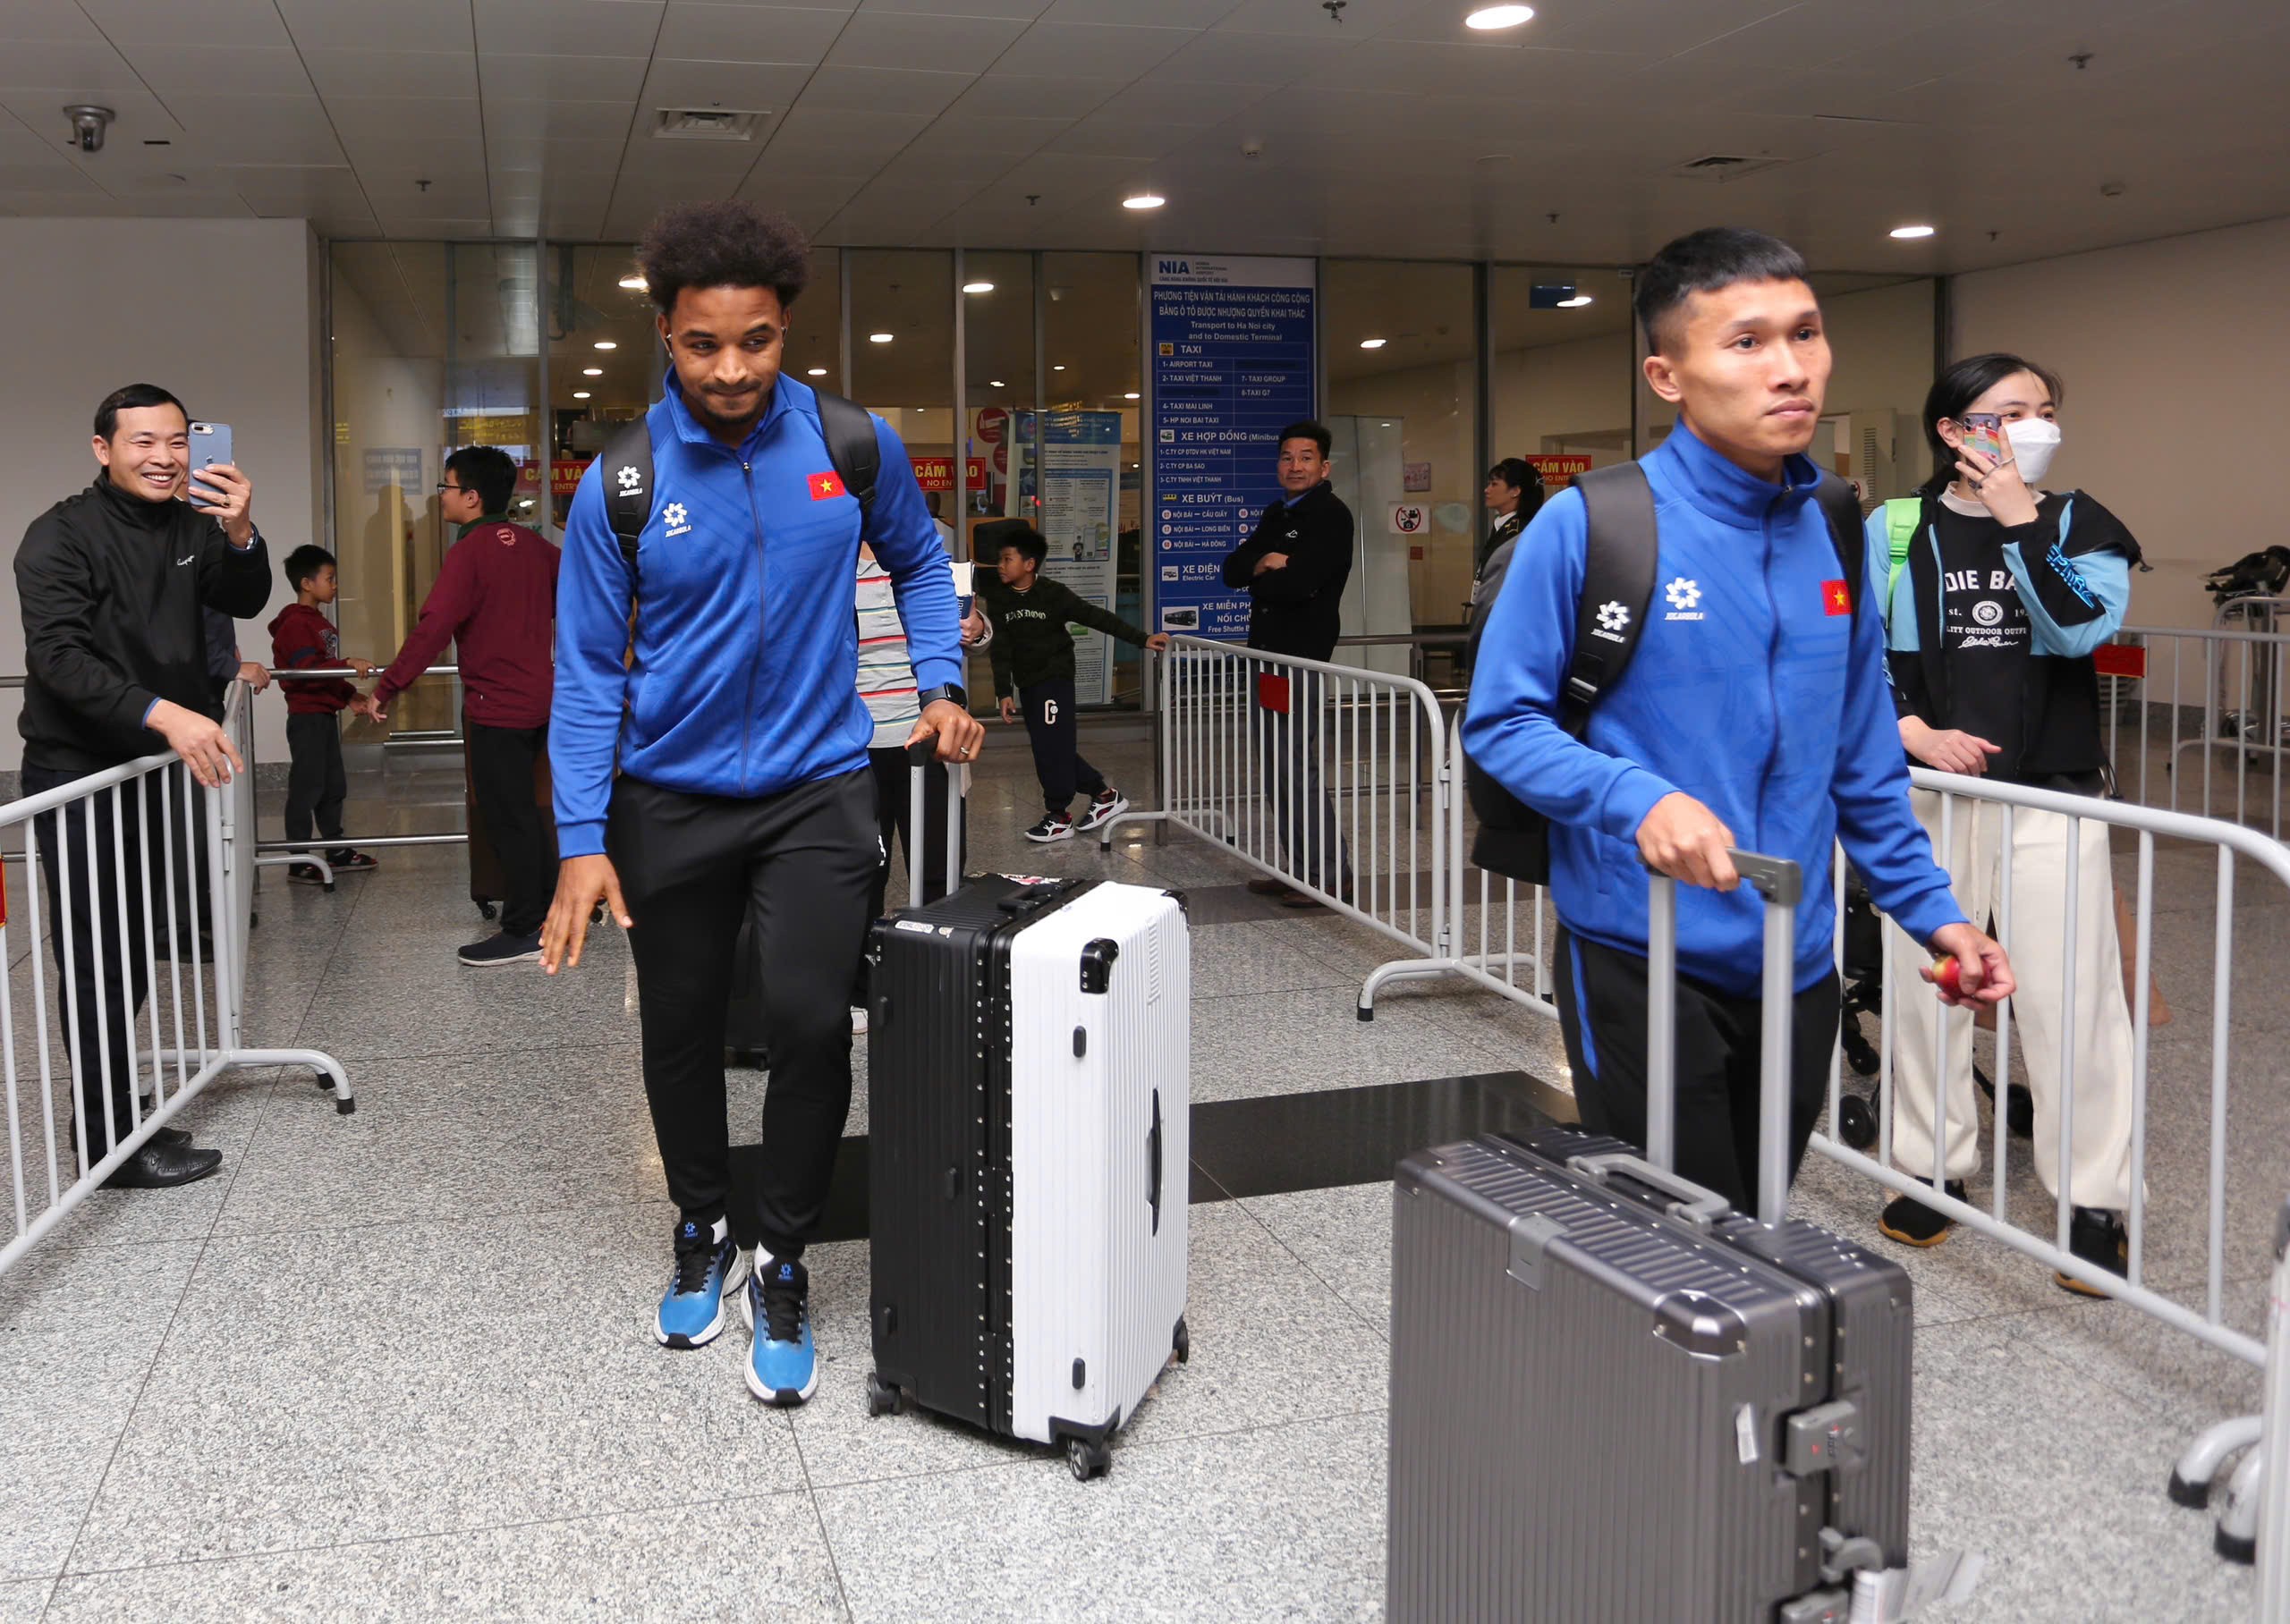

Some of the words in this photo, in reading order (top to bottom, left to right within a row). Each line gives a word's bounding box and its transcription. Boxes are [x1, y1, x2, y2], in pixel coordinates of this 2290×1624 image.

[1159, 261, 1190, 274] NIA
[1191, 321, 1226, 331] Transport
[1236, 322, 1247, 330] Ha
[1262, 323, 1276, 332] city
[1204, 333, 1212, 341] to
[1214, 333, 1249, 342] Domestic
[1251, 334, 1282, 342] Terminal
[1181, 345, 1202, 354] TAXI
[1181, 433, 1194, 441] XE
[1197, 431, 1217, 444] HỢP
[915, 461, 946, 478] CẤM
[1562, 460, 1585, 474] VÀO
[1182, 495, 1194, 503] XE
[1197, 492, 1222, 503] BUÝT
[1224, 495, 1243, 503] (Bus)
[1183, 565, 1195, 574] XE
[1197, 563, 1220, 575] ĐIỆN
[1223, 625, 1244, 633] Shuttle
[1964, 626, 2002, 635] OUTDOOR
